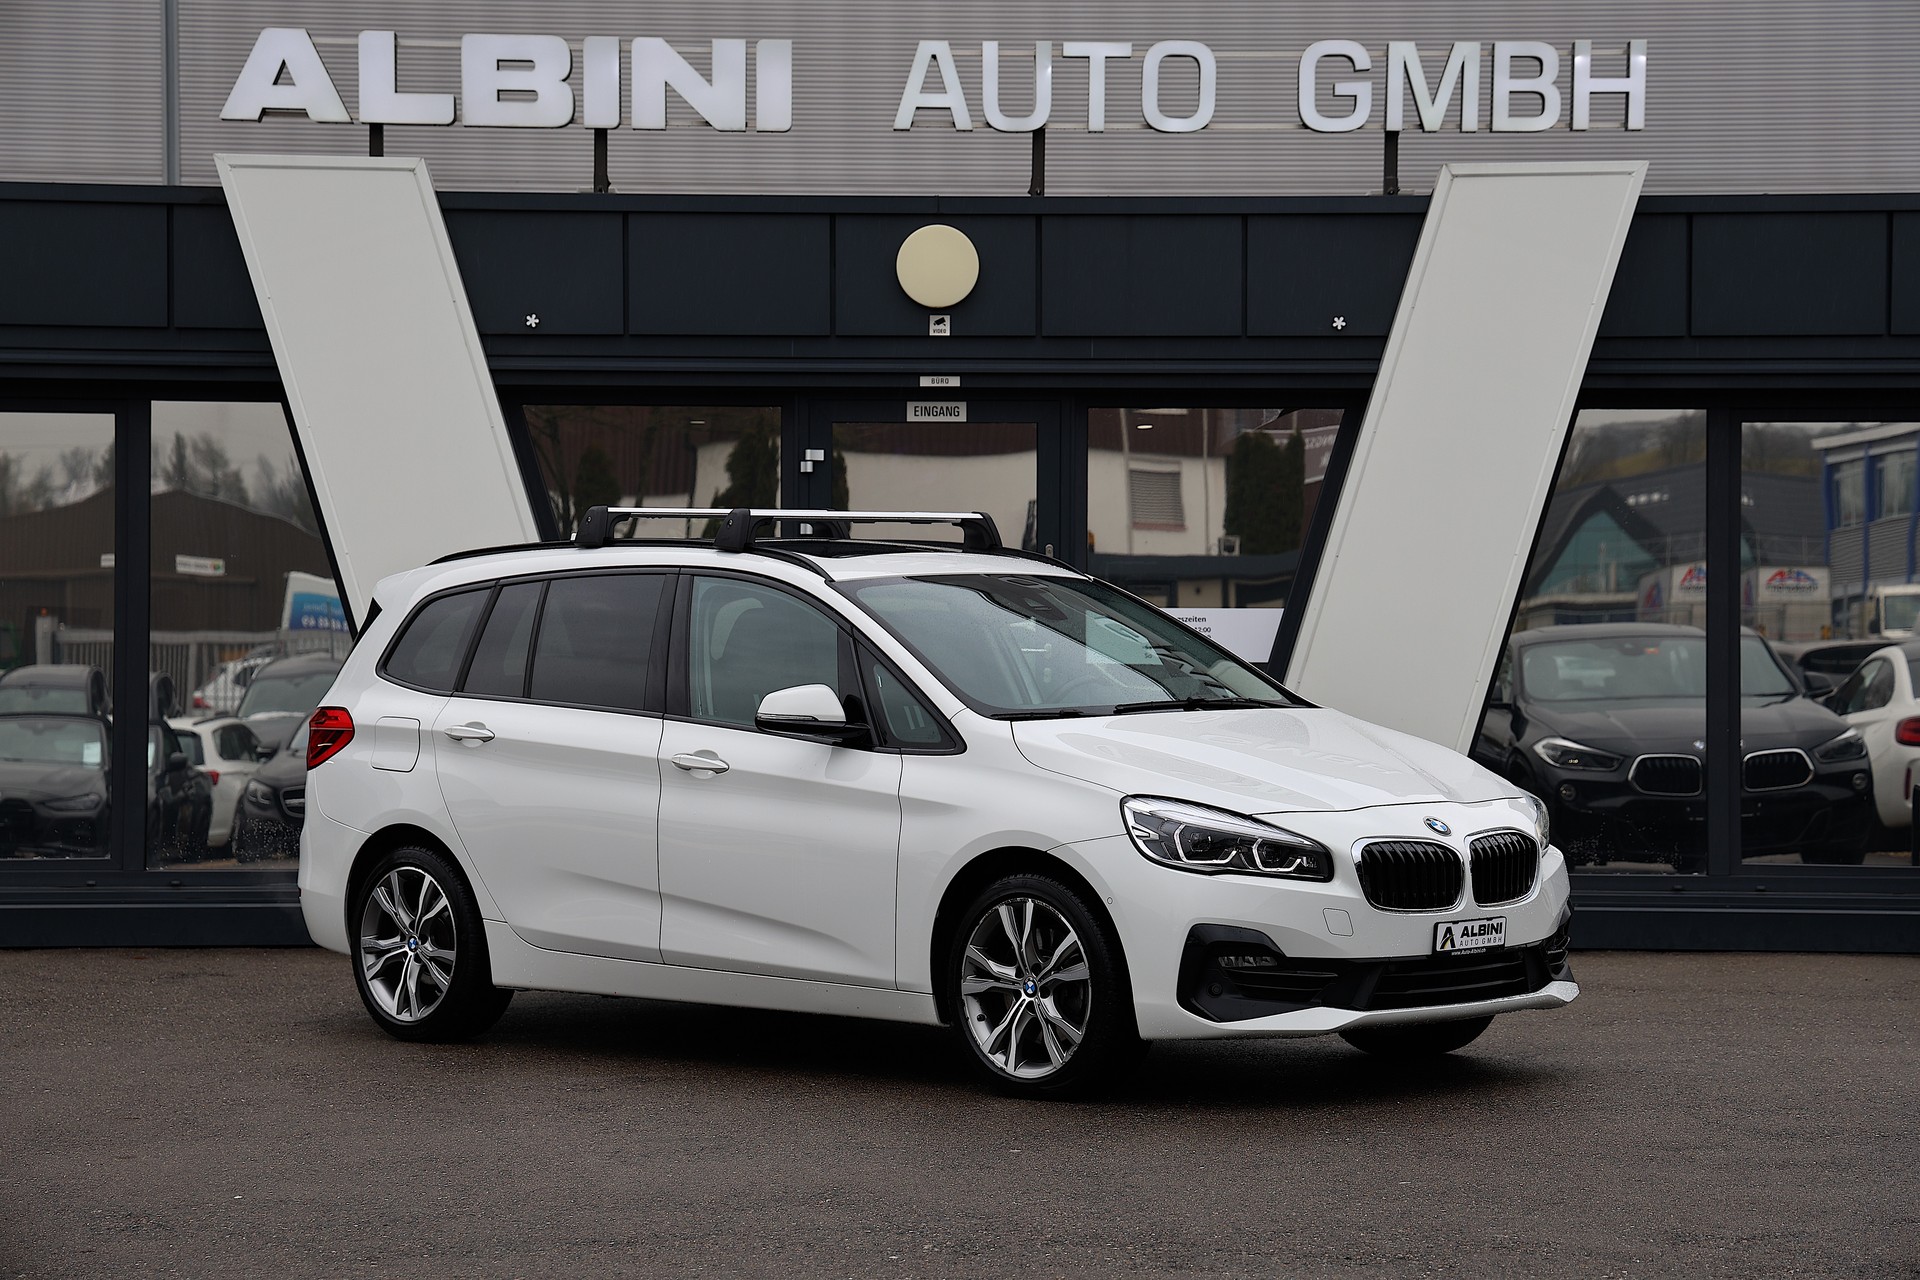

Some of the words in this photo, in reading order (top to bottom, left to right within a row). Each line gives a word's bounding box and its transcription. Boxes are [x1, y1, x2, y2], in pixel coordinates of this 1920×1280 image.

[220, 27, 793, 132] ALBINI
[893, 40, 1217, 133] AUTO
[1297, 39, 1648, 133] GMBH
[931, 377, 950, 385] BÜRO
[913, 405, 960, 417] EINGANG
[1460, 922, 1503, 938] ALBINI
[1460, 939, 1479, 947] AUTO
[1482, 936, 1503, 945] GMBH
